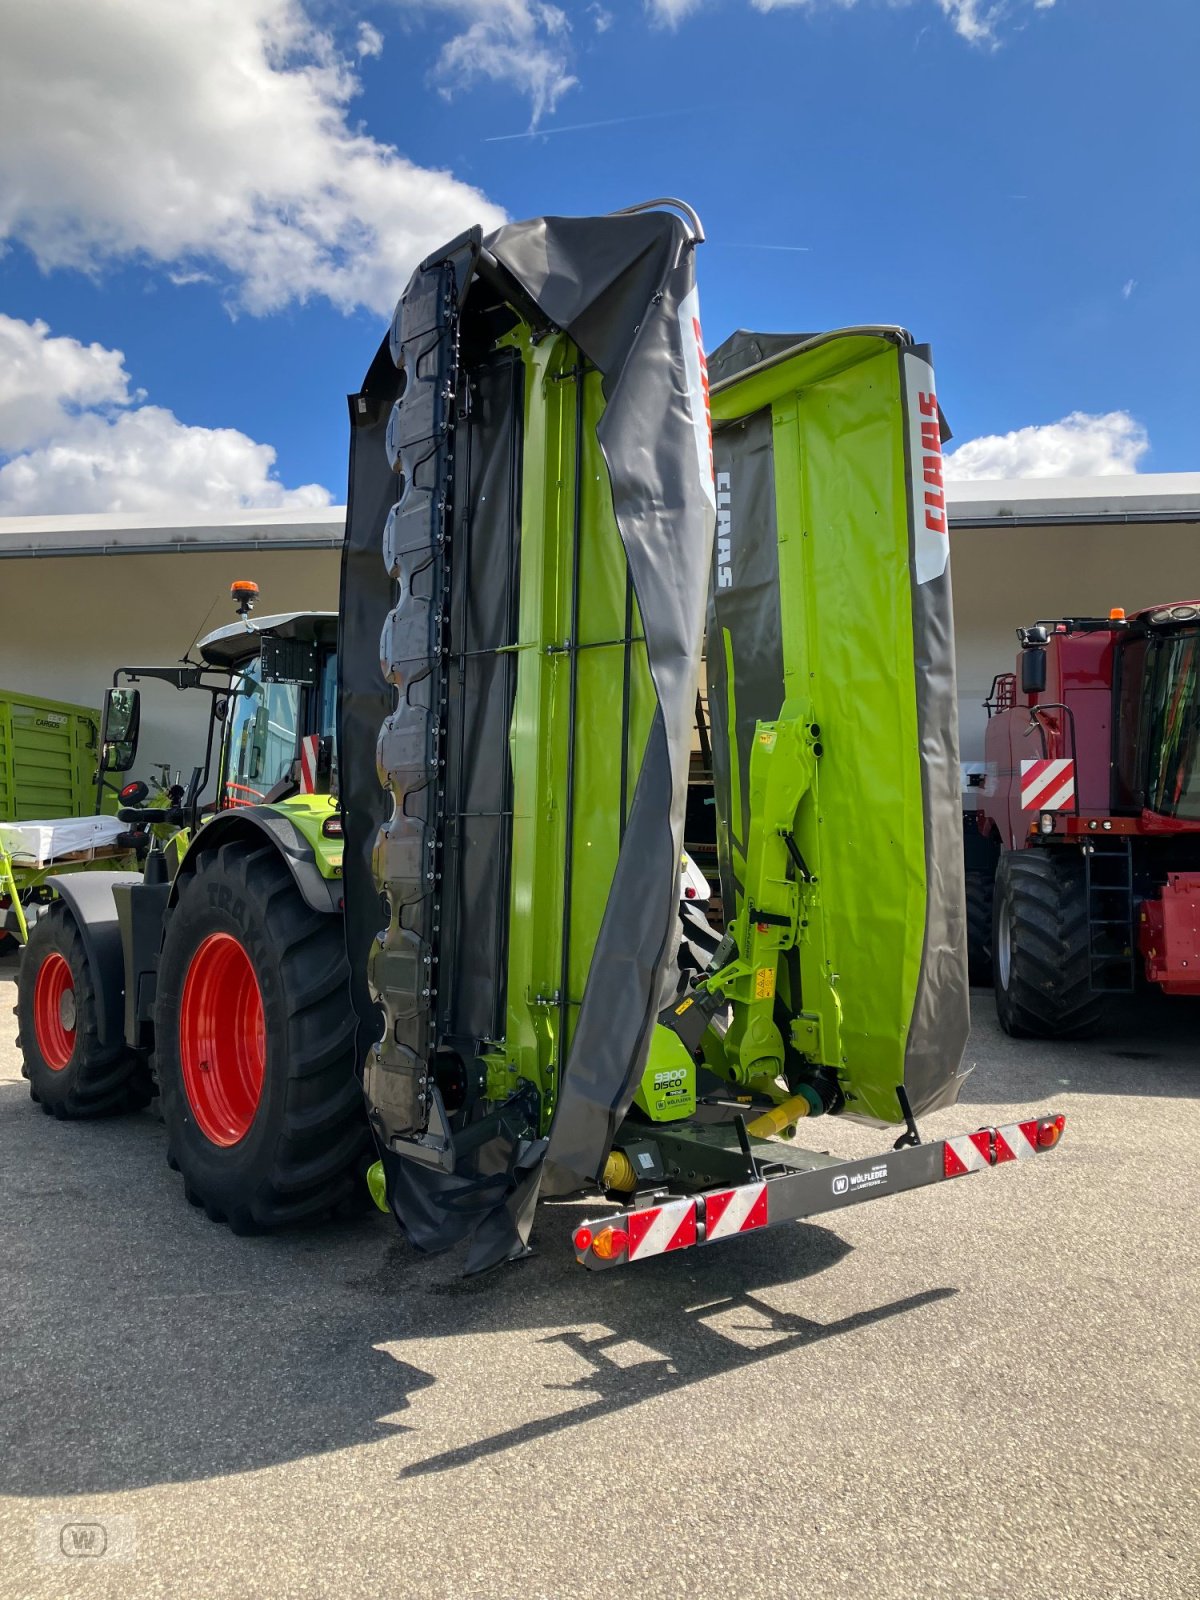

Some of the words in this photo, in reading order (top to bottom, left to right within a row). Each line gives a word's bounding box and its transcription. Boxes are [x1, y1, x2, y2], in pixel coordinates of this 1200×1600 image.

[918, 391, 946, 534] CLAAS
[717, 471, 733, 588] CLAAS
[654, 1069, 687, 1084] 9300
[654, 1079, 682, 1091] DISCO
